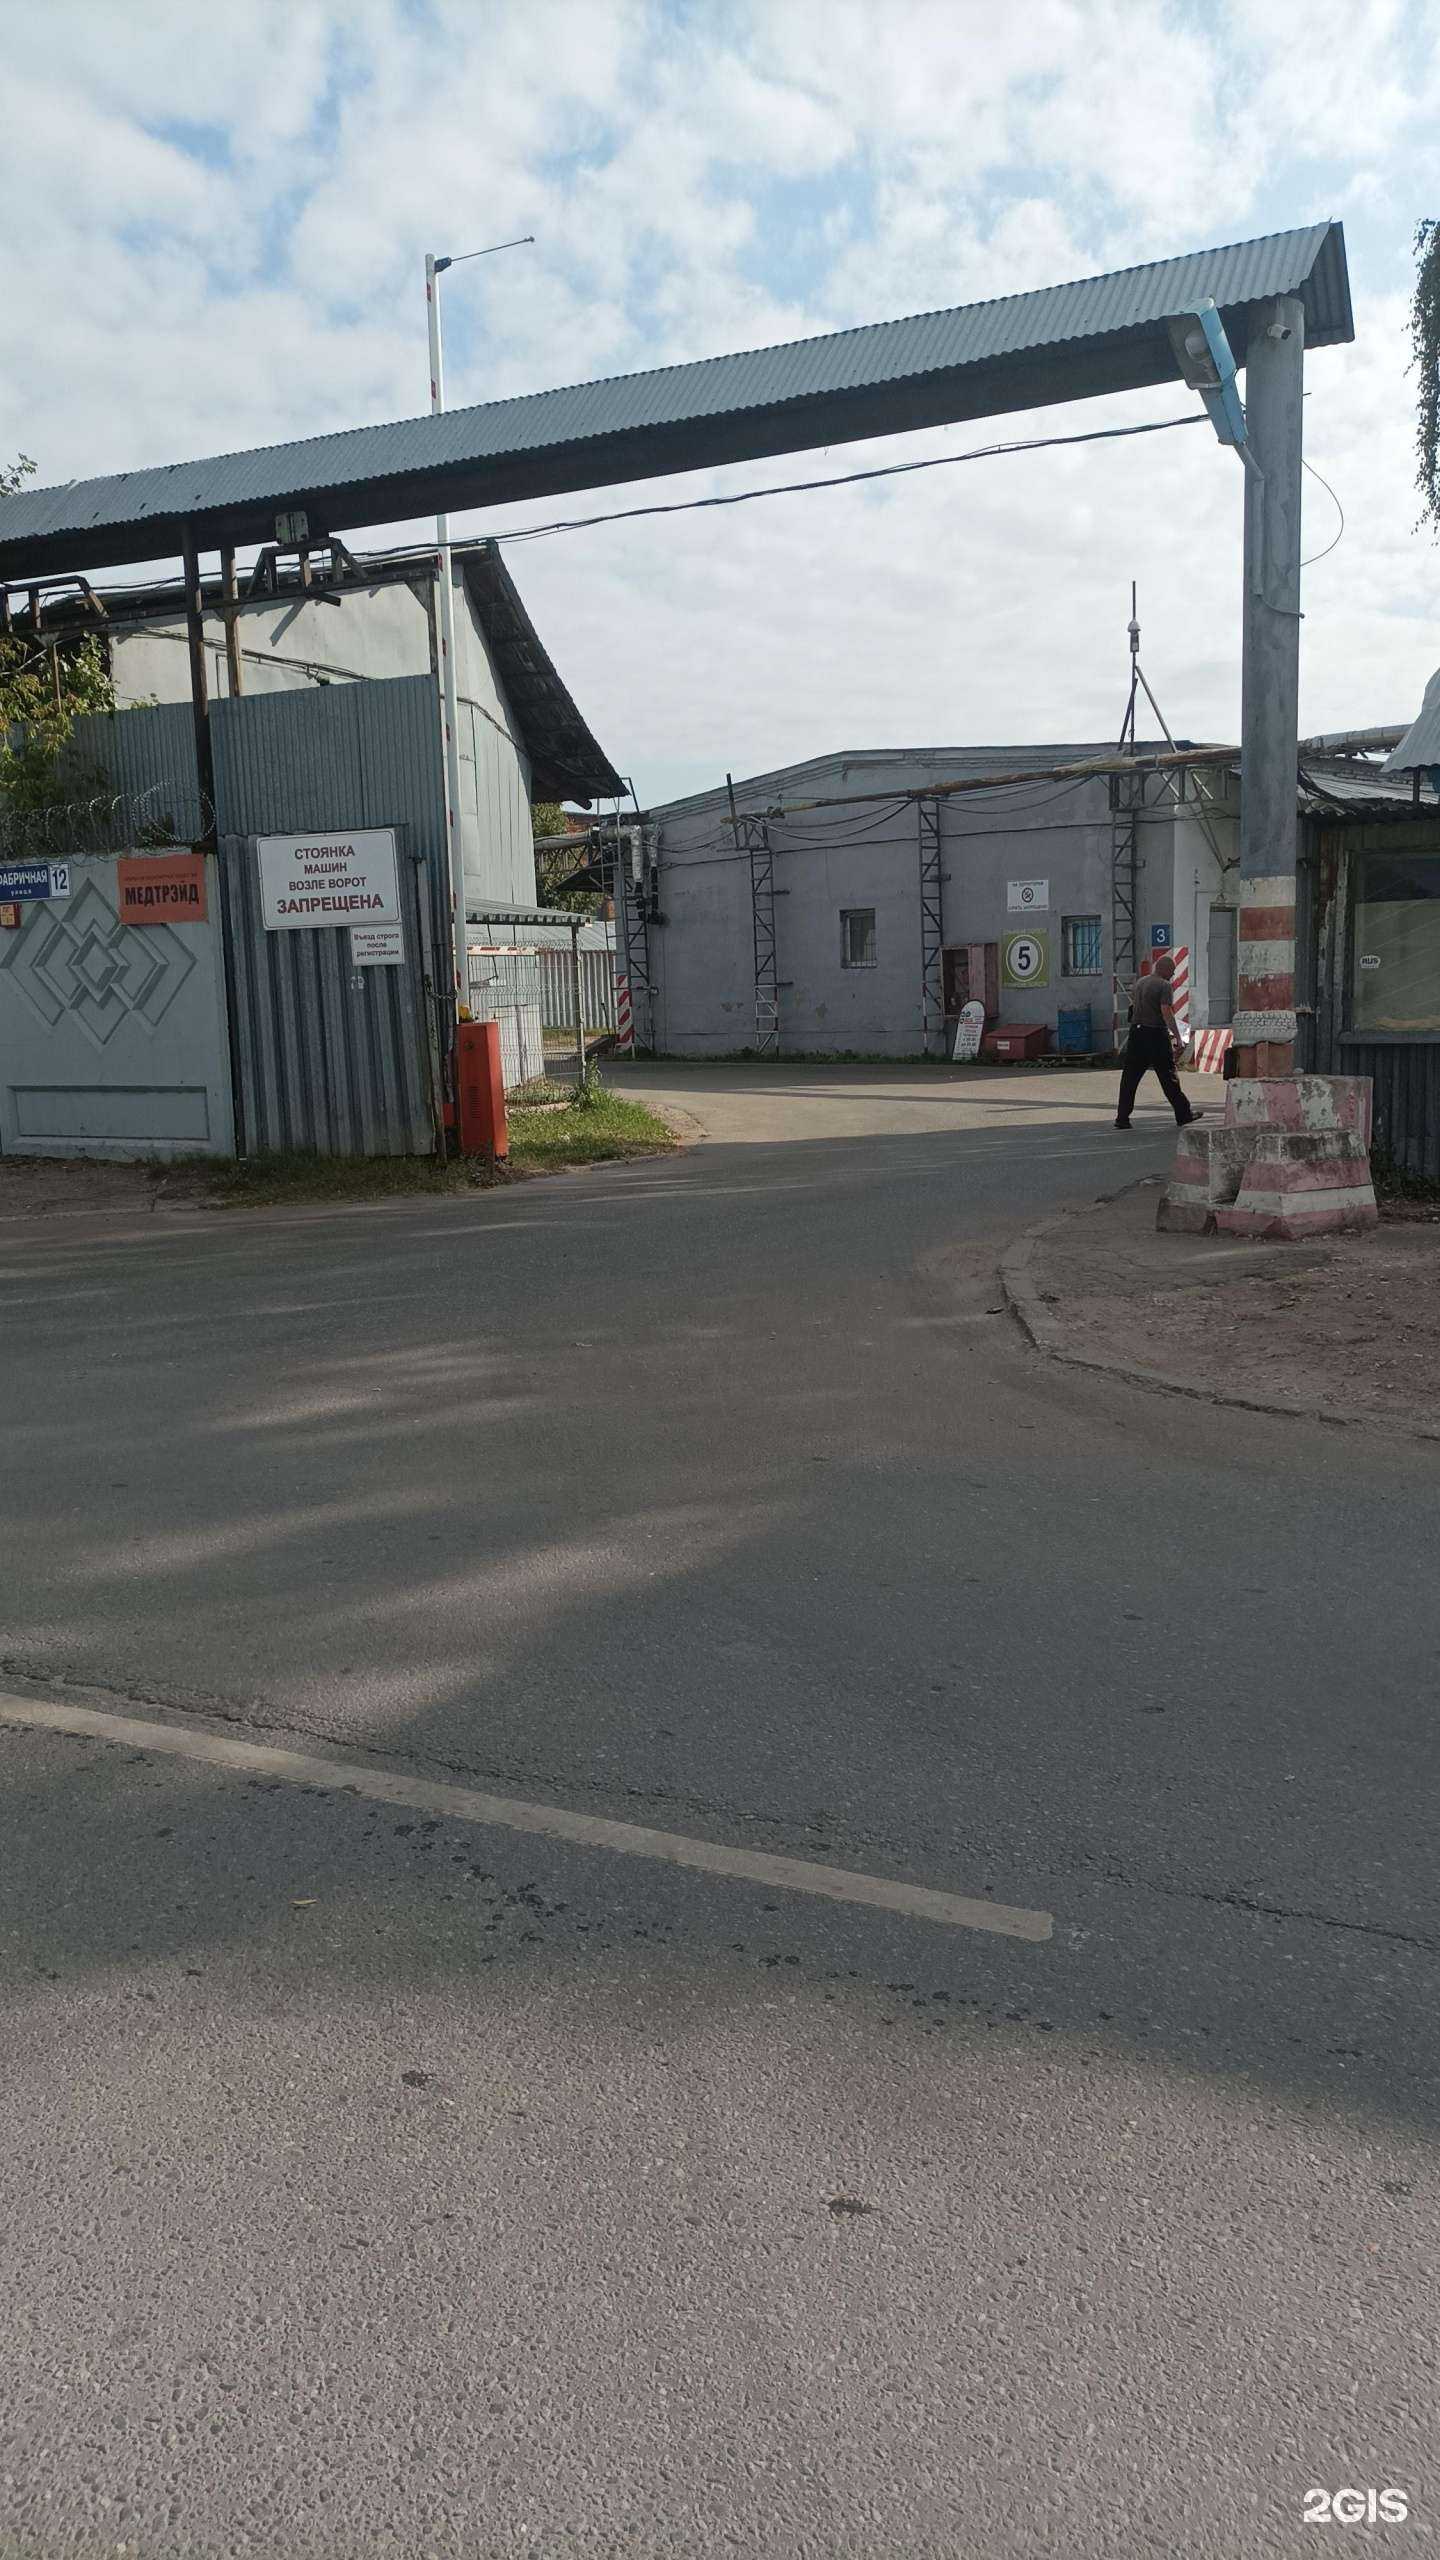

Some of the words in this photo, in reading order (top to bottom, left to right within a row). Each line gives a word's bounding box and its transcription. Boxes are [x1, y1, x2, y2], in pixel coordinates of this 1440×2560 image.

[294, 845, 355, 860] СТОЯНКА
[304, 862, 347, 875] МАШИН
[52, 869, 68, 890] 12
[288, 880, 326, 891] ВОЗЛЕ
[328, 877, 367, 889] ВОРОТ
[125, 880, 200, 907] МЕДТРЭЙД
[277, 894, 384, 914] ЗАПРЕЩЕНА
[1156, 928, 1167, 943] 3
[1018, 946, 1031, 970] 5
